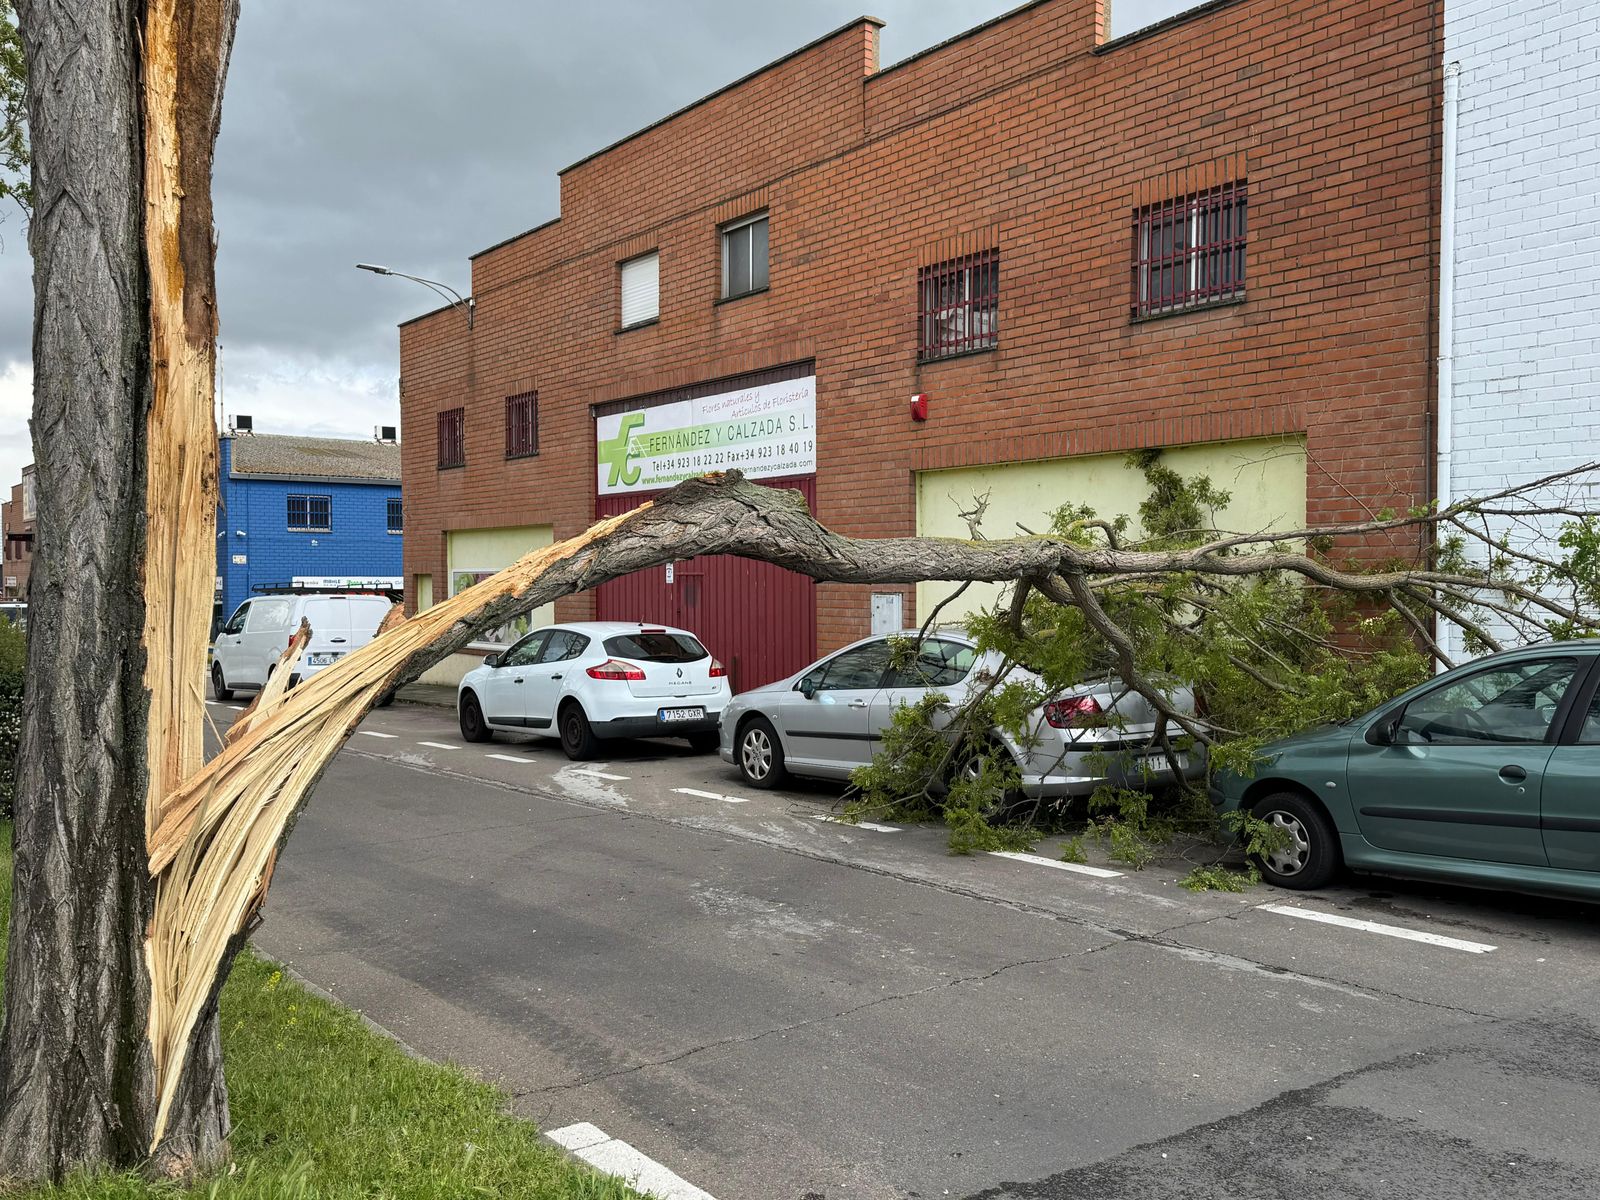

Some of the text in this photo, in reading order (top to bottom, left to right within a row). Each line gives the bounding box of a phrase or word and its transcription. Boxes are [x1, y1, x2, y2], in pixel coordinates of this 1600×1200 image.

[702, 391, 760, 414] Flores naturales y
[763, 400, 771, 410] de
[649, 429, 710, 453] FERNÁNDEZ
[716, 427, 722, 442] Y
[727, 417, 783, 441] CALZADA
[652, 440, 813, 472] Tel+34 923 18 22 22 Fax+34 923 18 40 19
[666, 708, 702, 719] 7152 GXR
